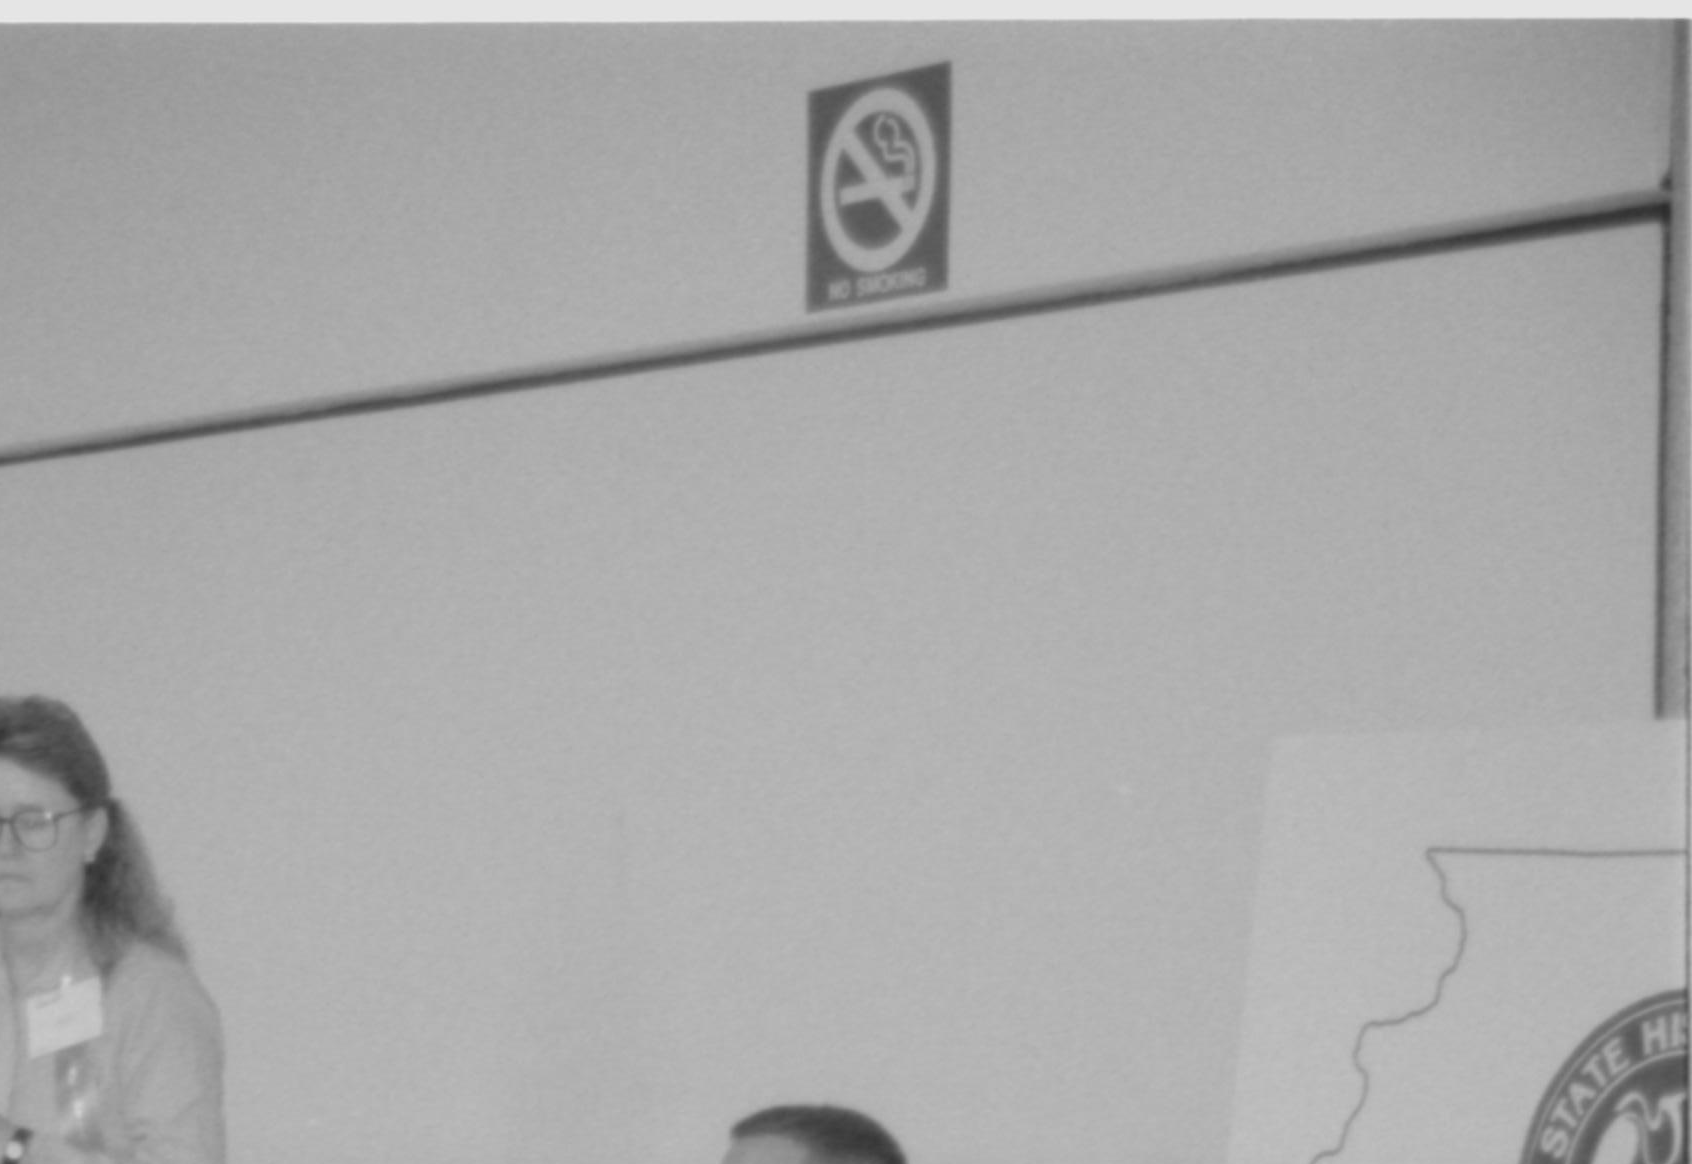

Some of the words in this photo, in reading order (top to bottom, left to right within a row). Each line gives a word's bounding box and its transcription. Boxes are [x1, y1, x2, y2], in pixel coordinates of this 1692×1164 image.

[828, 278, 851, 301] NO
[856, 266, 928, 298] SMOKING
[1540, 1036, 1631, 1159] STATE
